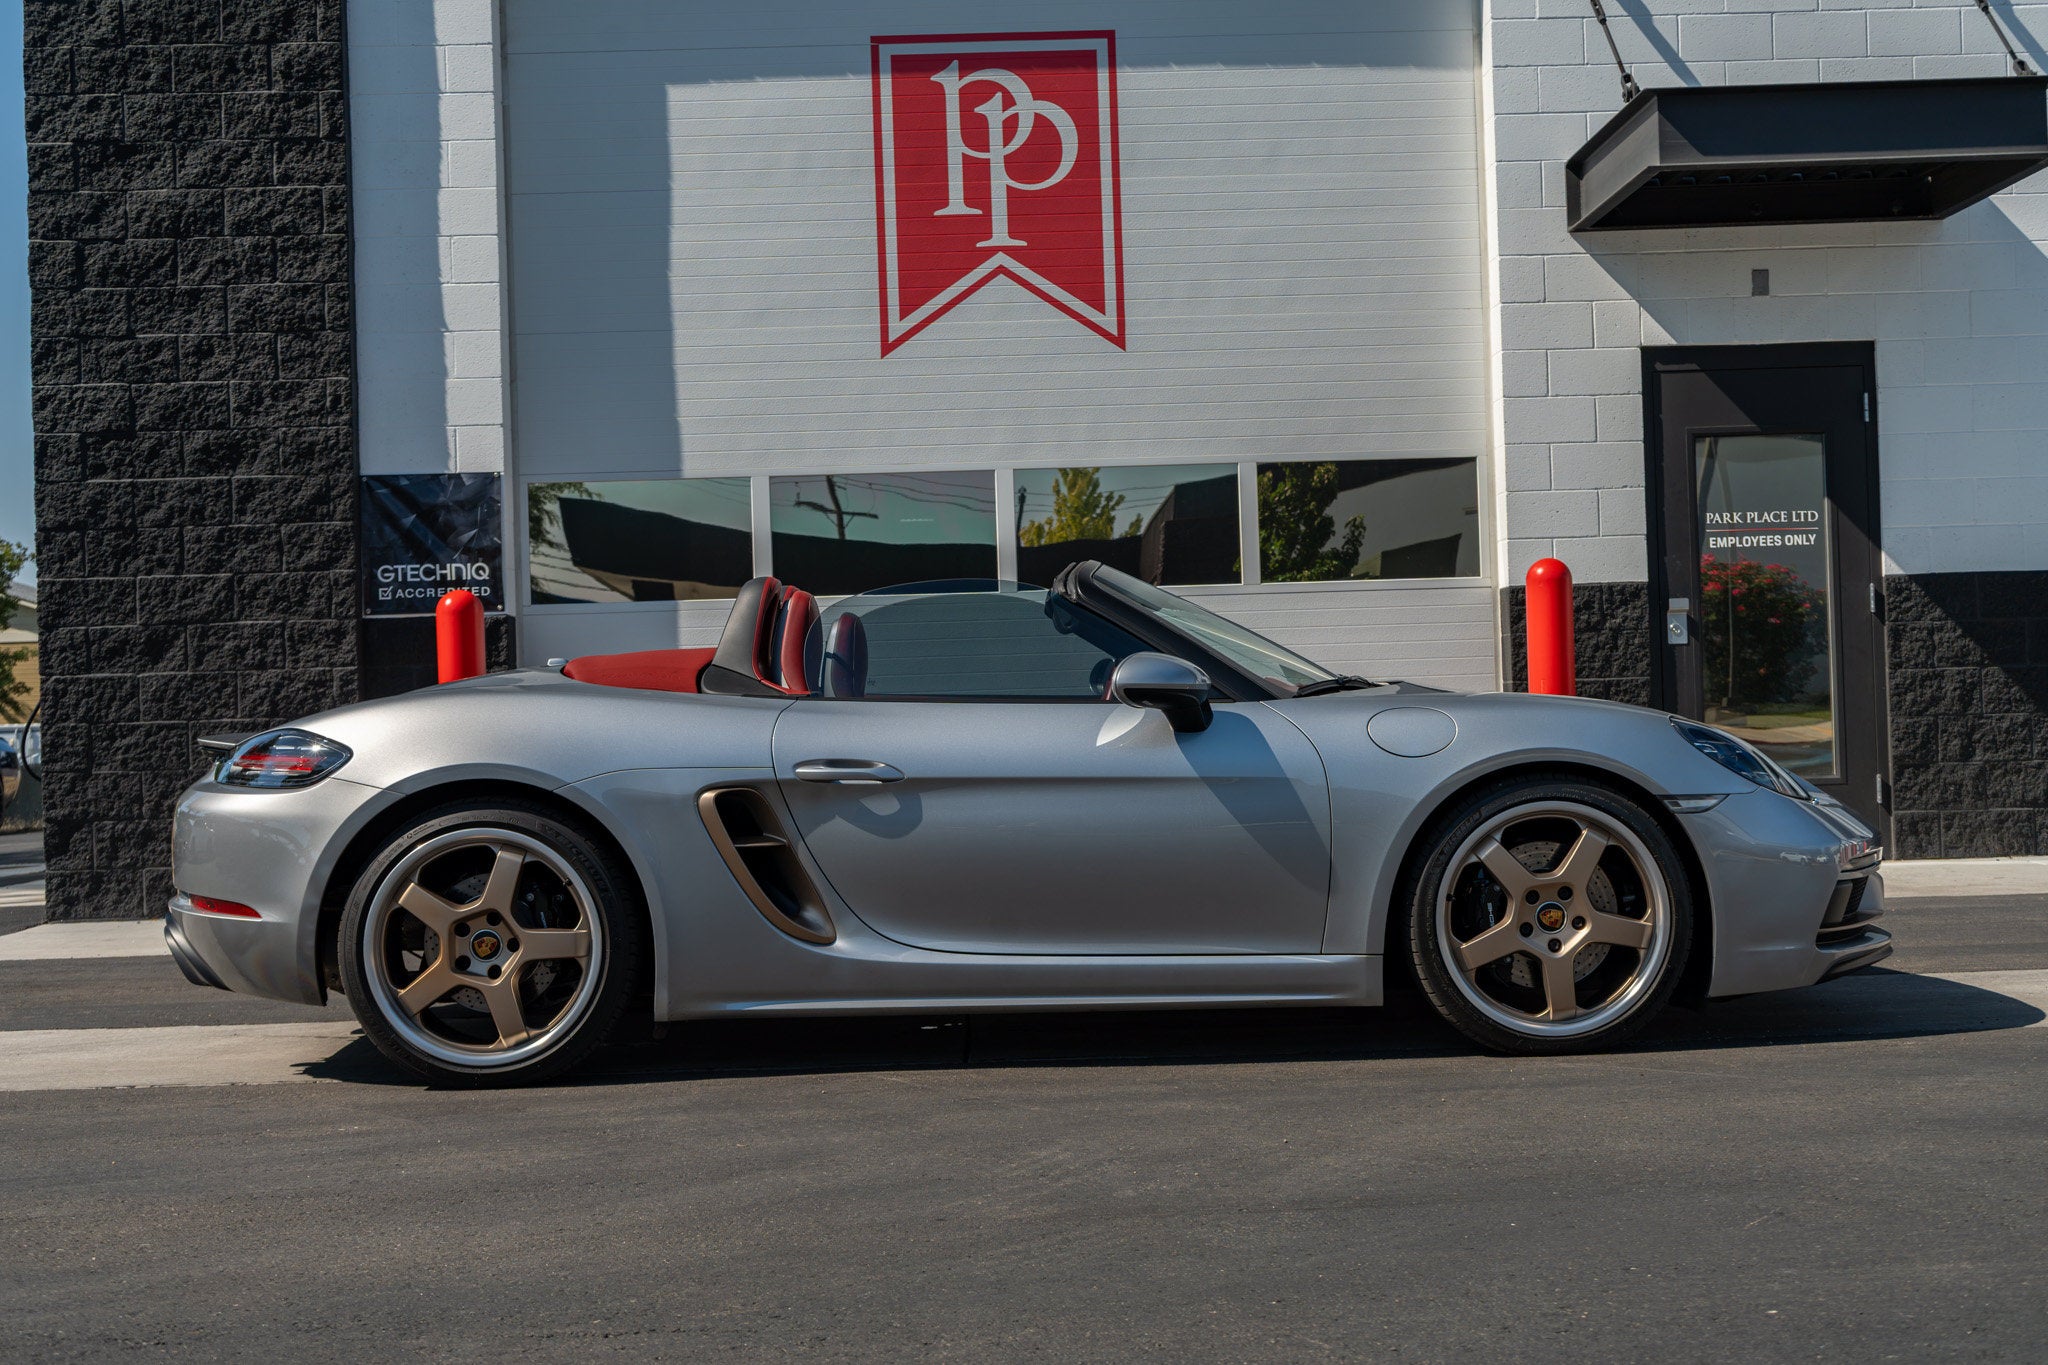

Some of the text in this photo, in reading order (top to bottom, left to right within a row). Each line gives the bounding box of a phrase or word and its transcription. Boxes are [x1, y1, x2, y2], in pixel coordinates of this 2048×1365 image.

[1706, 510, 1819, 524] PARK PLACE LTD
[1709, 534, 1817, 548] EMPLOYEES ONLY
[395, 586, 491, 598] ACCREED
